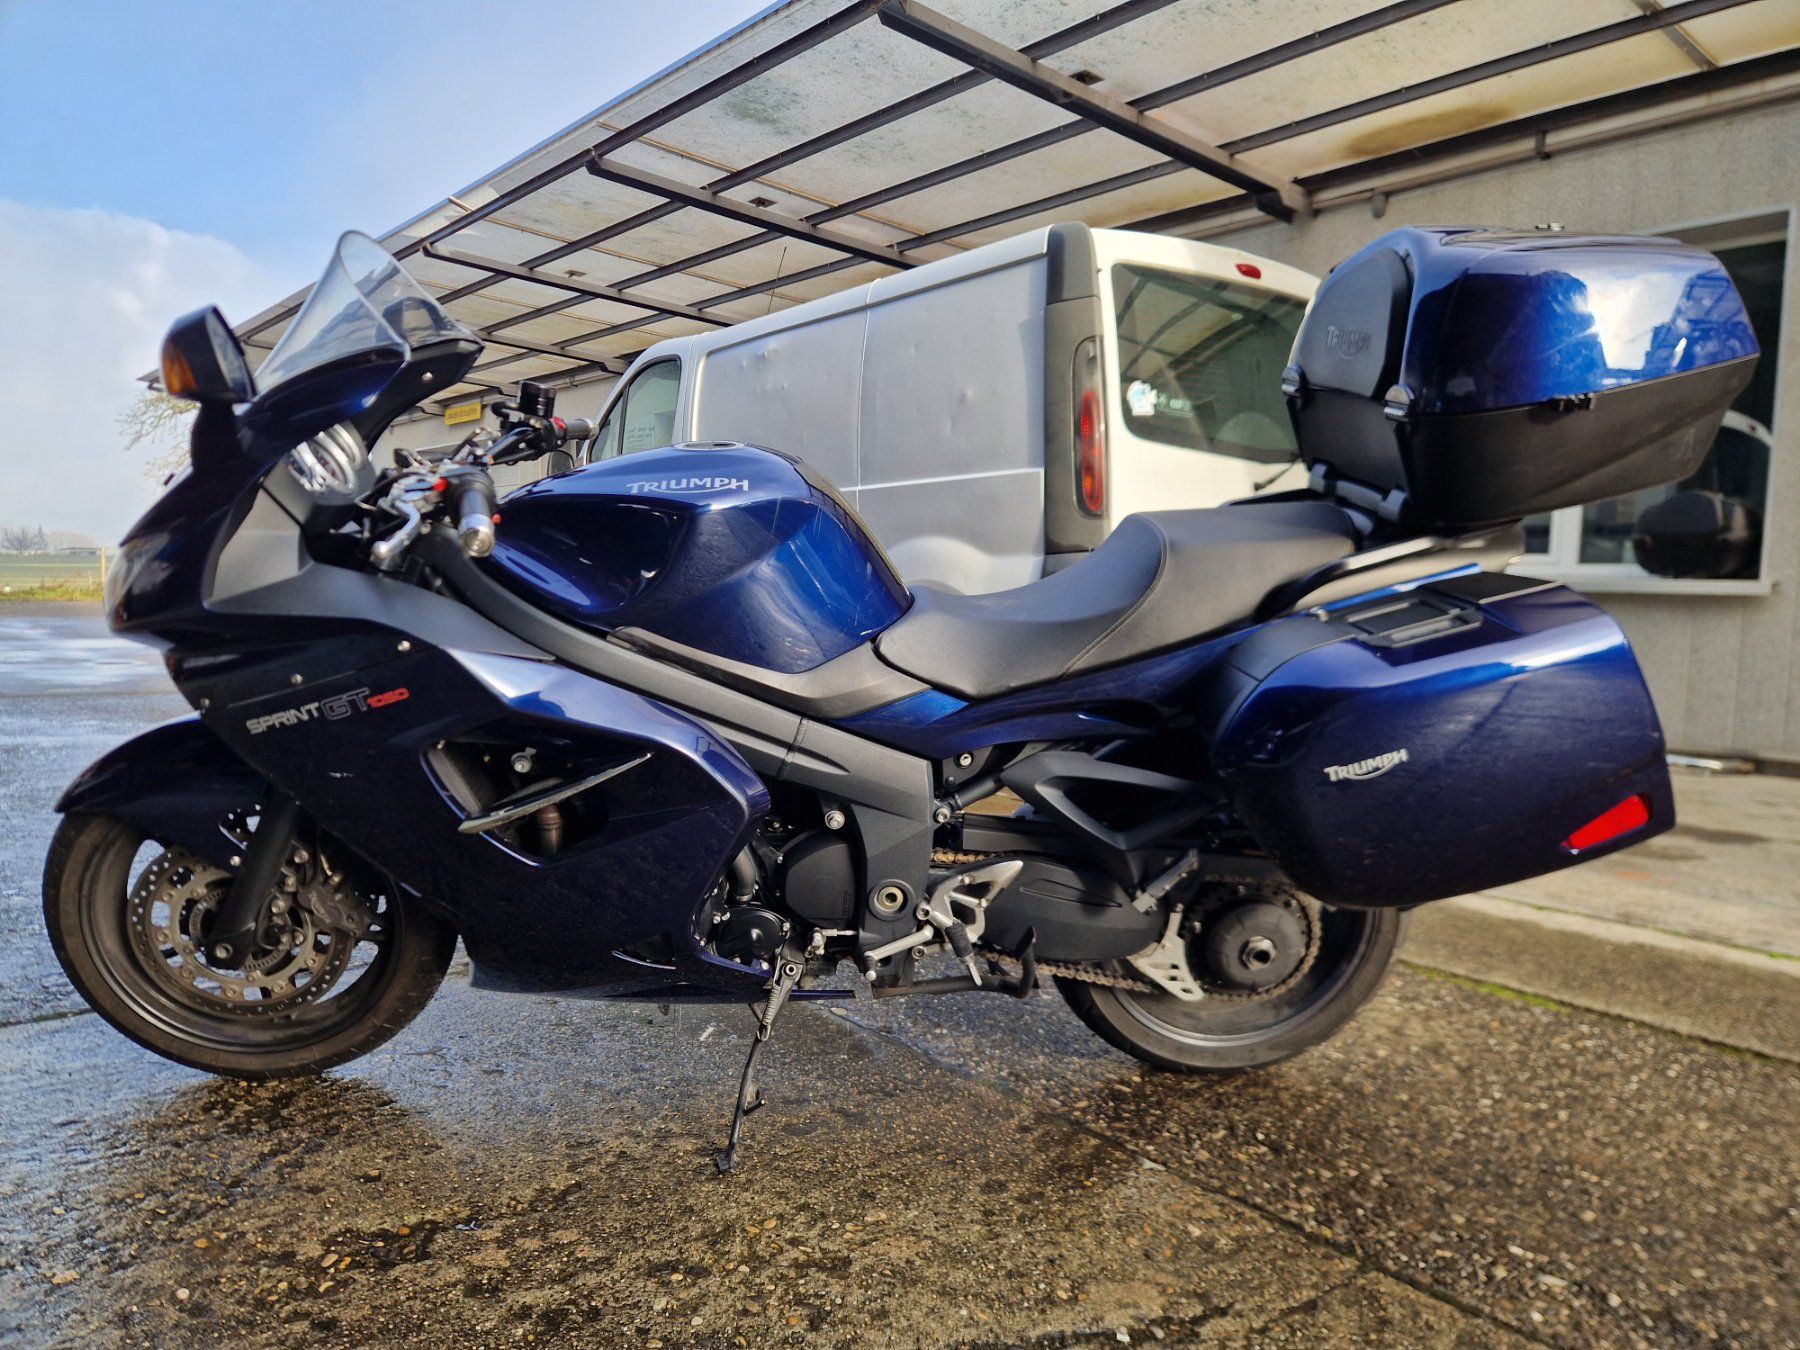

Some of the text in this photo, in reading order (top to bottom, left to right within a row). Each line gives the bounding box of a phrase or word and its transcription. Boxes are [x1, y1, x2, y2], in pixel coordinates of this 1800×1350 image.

[626, 477, 749, 495] TRIUMPH
[246, 702, 320, 735] SPRINT
[320, 687, 371, 721] GT
[1323, 748, 1409, 782] TRIUMPH
